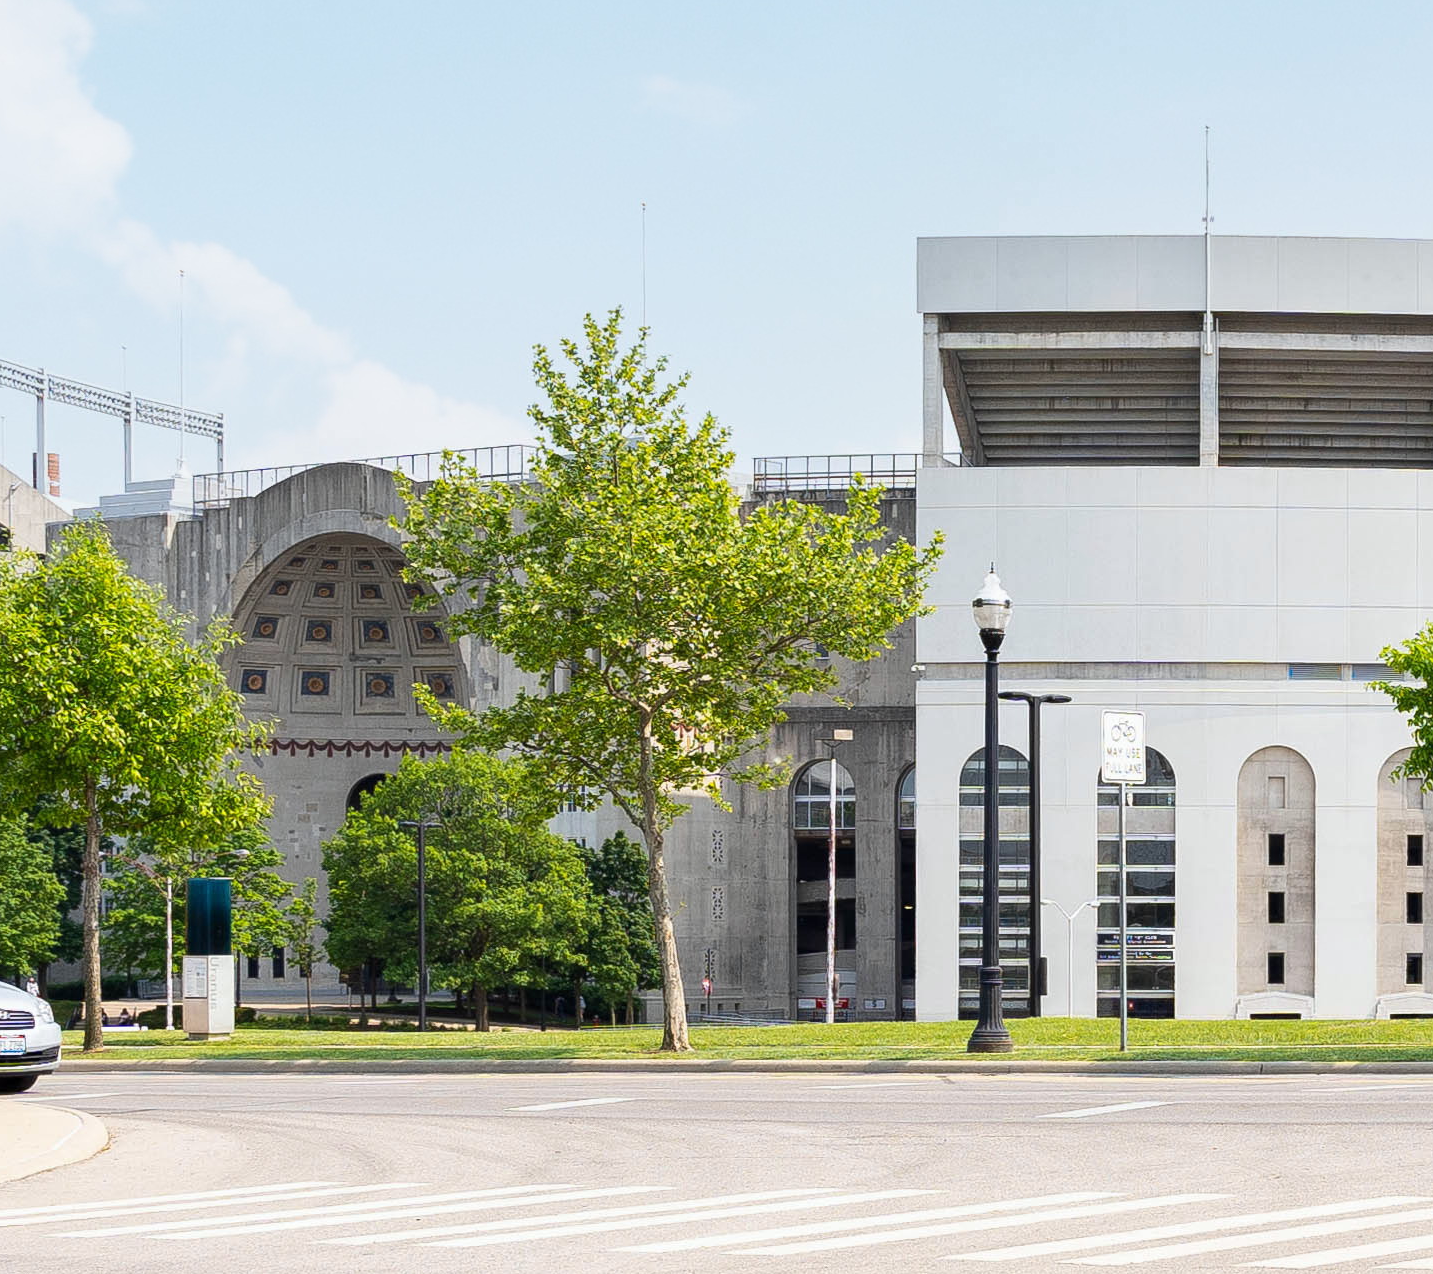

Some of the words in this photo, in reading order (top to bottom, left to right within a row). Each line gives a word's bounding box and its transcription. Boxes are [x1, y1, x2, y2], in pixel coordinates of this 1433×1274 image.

[1107, 746, 1122, 757] MAY
[1126, 747, 1141, 759] USE
[1125, 763, 1142, 774] LANE
